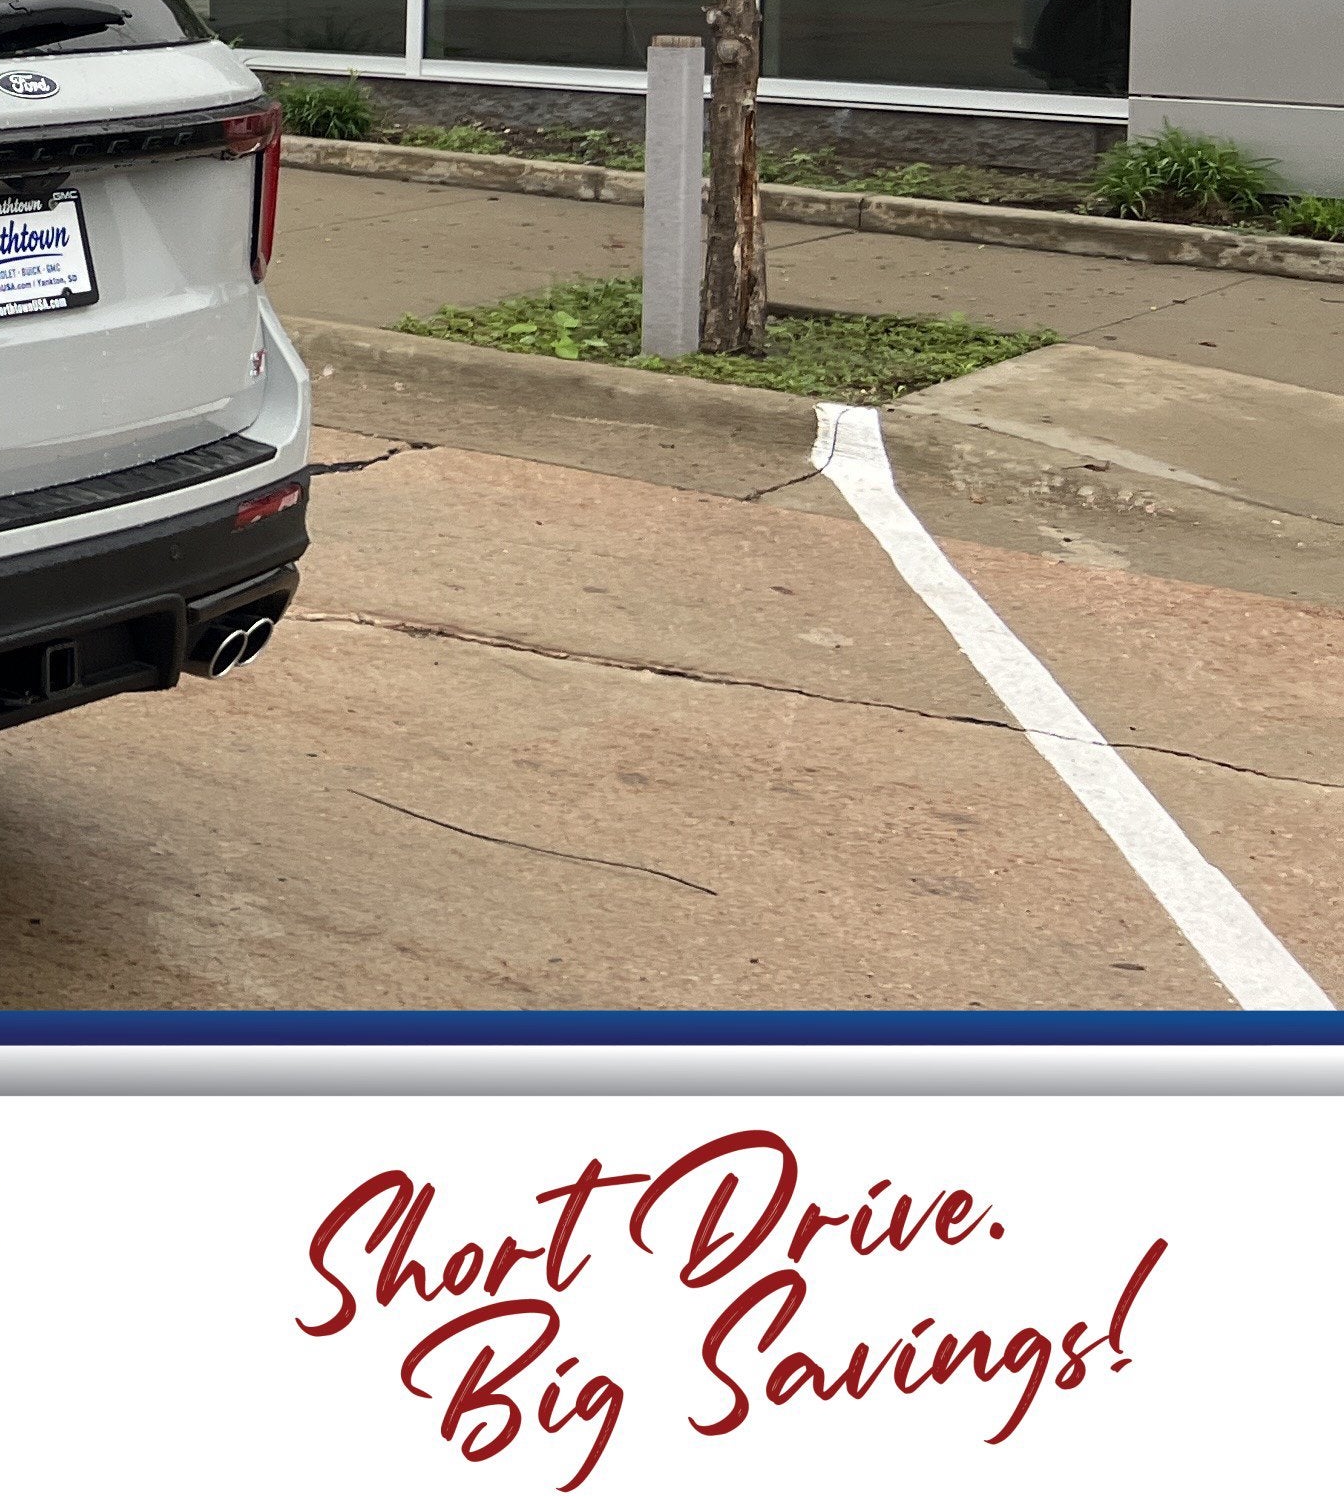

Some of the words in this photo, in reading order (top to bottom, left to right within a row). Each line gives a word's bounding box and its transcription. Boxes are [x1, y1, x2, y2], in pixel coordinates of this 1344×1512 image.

[9, 74, 50, 93] Ford
[53, 191, 78, 200] GMC
[21, 265, 41, 277] BUICK
[46, 263, 61, 274] GMC
